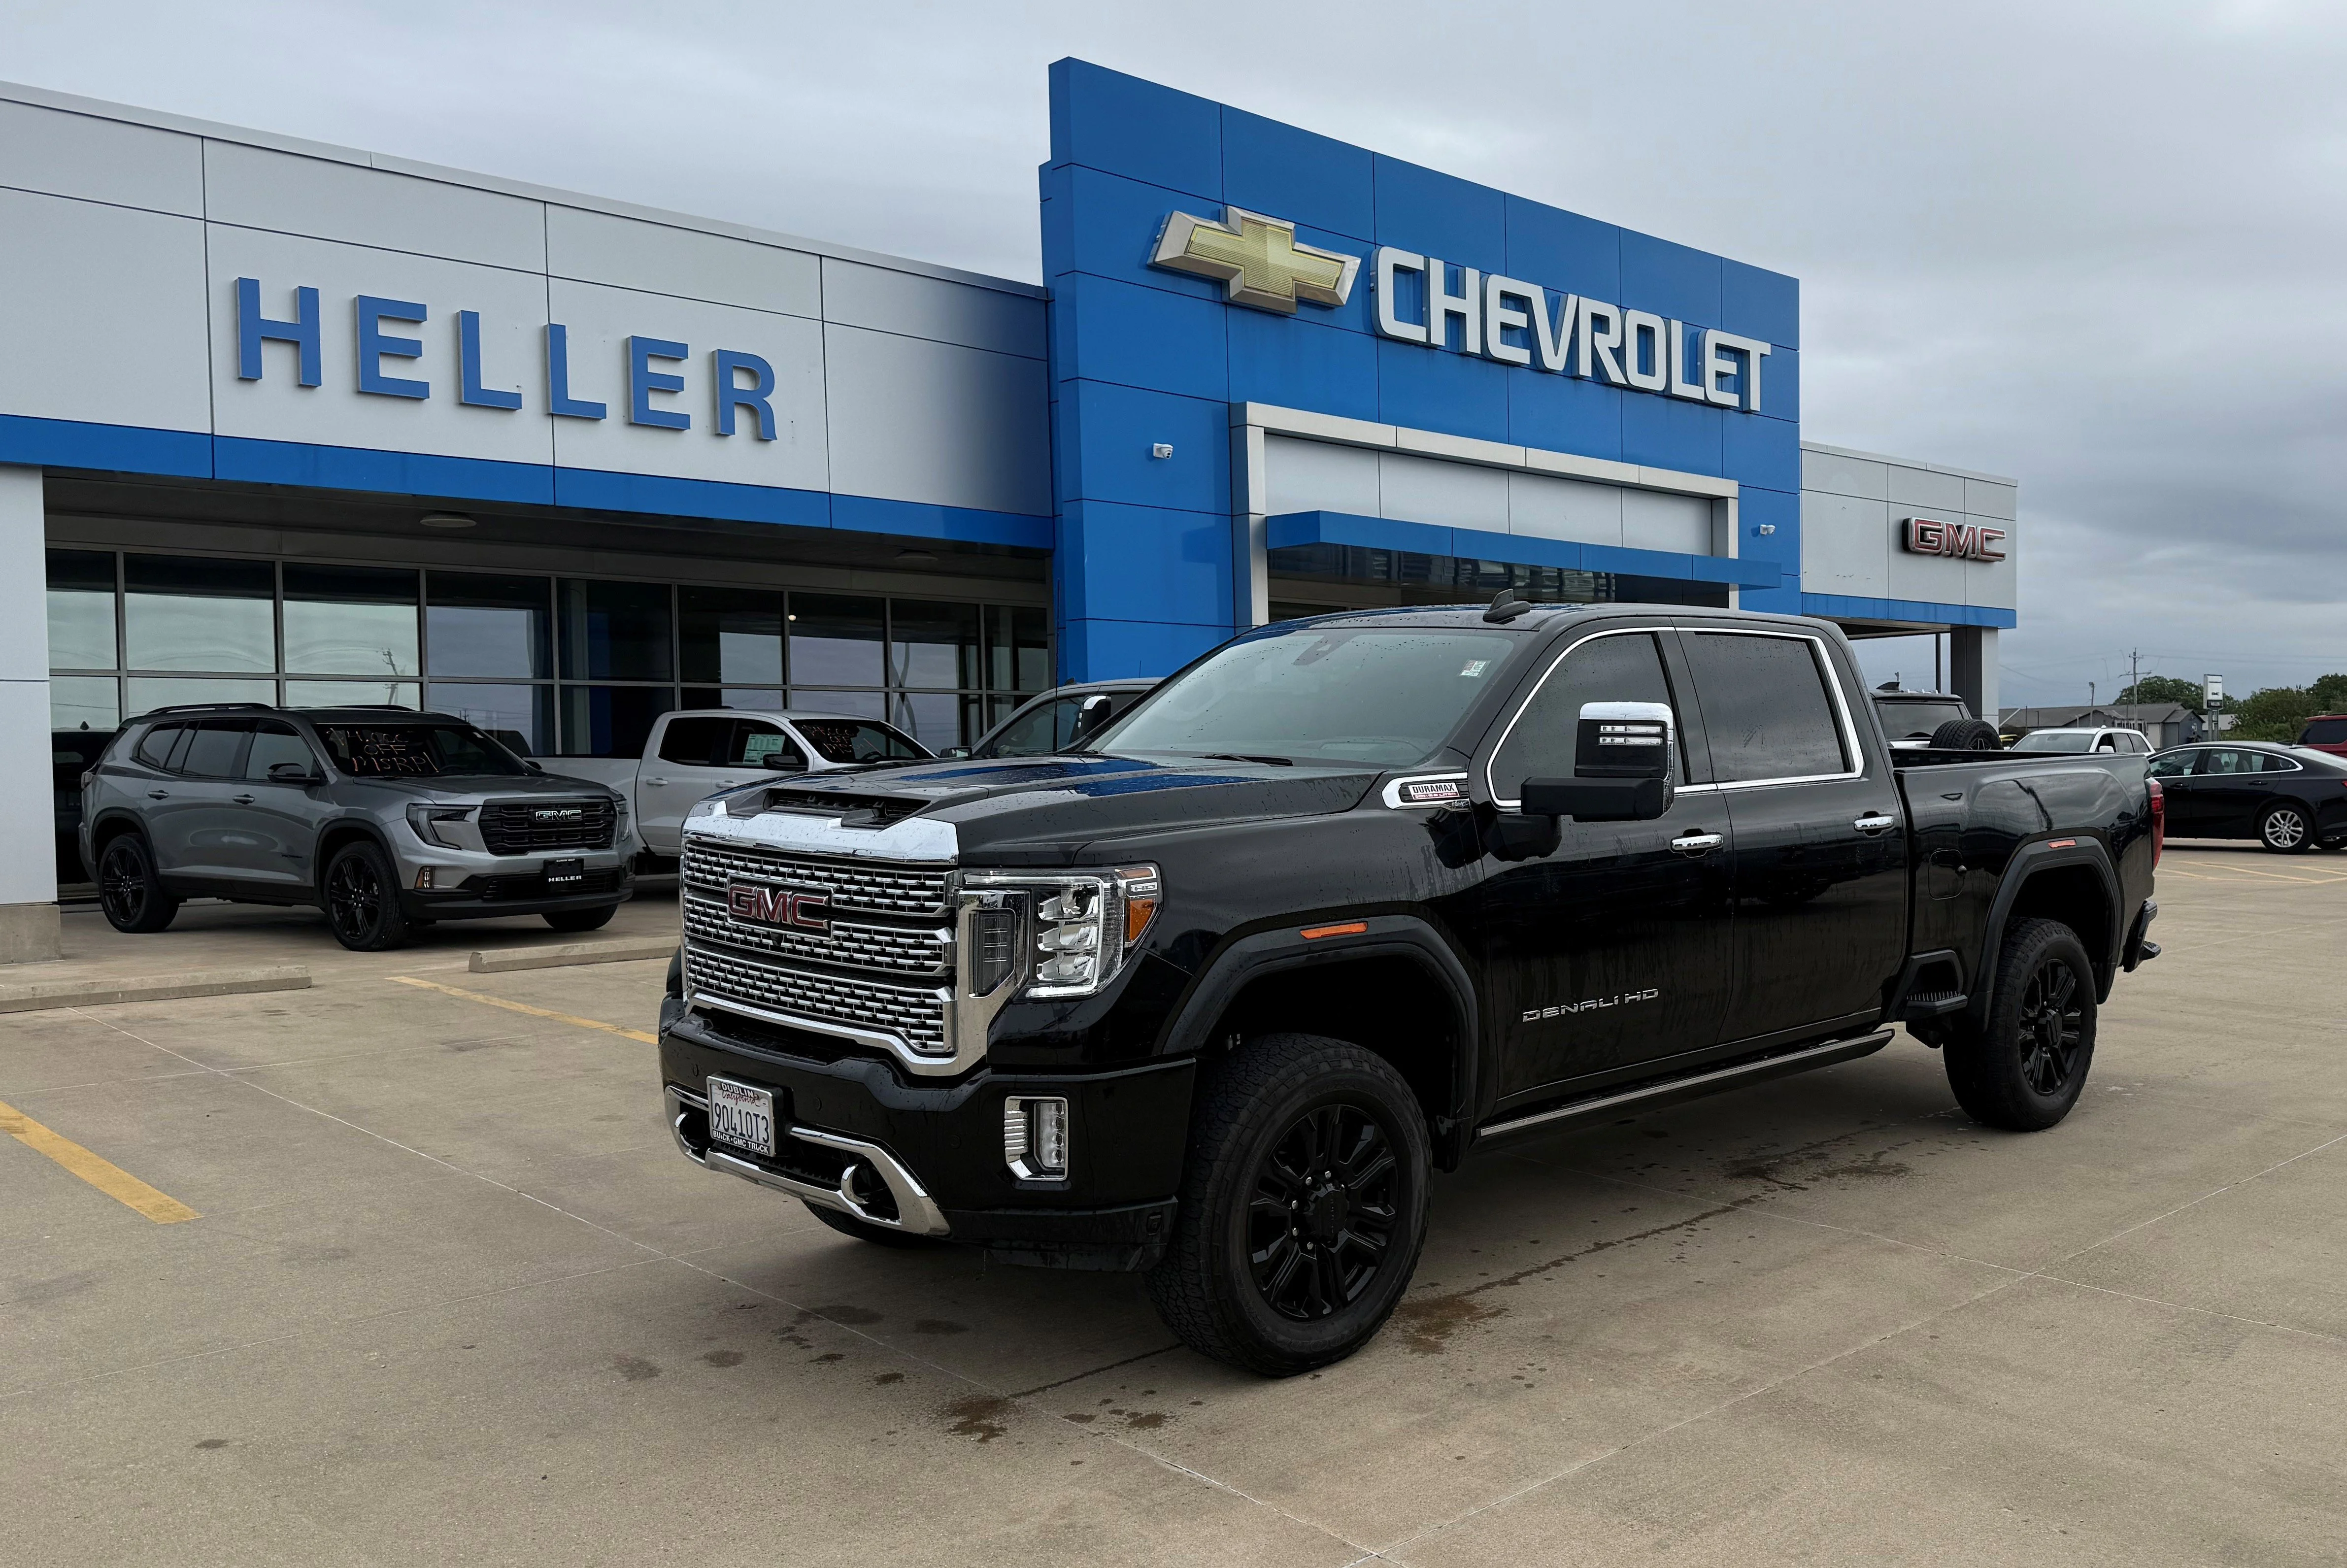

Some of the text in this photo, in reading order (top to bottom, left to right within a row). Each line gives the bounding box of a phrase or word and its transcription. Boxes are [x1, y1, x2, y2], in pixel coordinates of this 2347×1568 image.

[1372, 246, 1771, 413] CHEVROLET
[235, 276, 778, 441] HELLER
[1905, 517, 2007, 562] GMC
[364, 744, 405, 755] OFF
[1412, 784, 1455, 794] DURAMAX
[536, 810, 582, 821] GMC
[728, 883, 829, 930] GMC
[1523, 989, 1658, 1022] DENALI HD
[721, 1083, 754, 1098] DUBLIN
[715, 1102, 770, 1143] 90410T3
[747, 1141, 769, 1154] TRUCK
